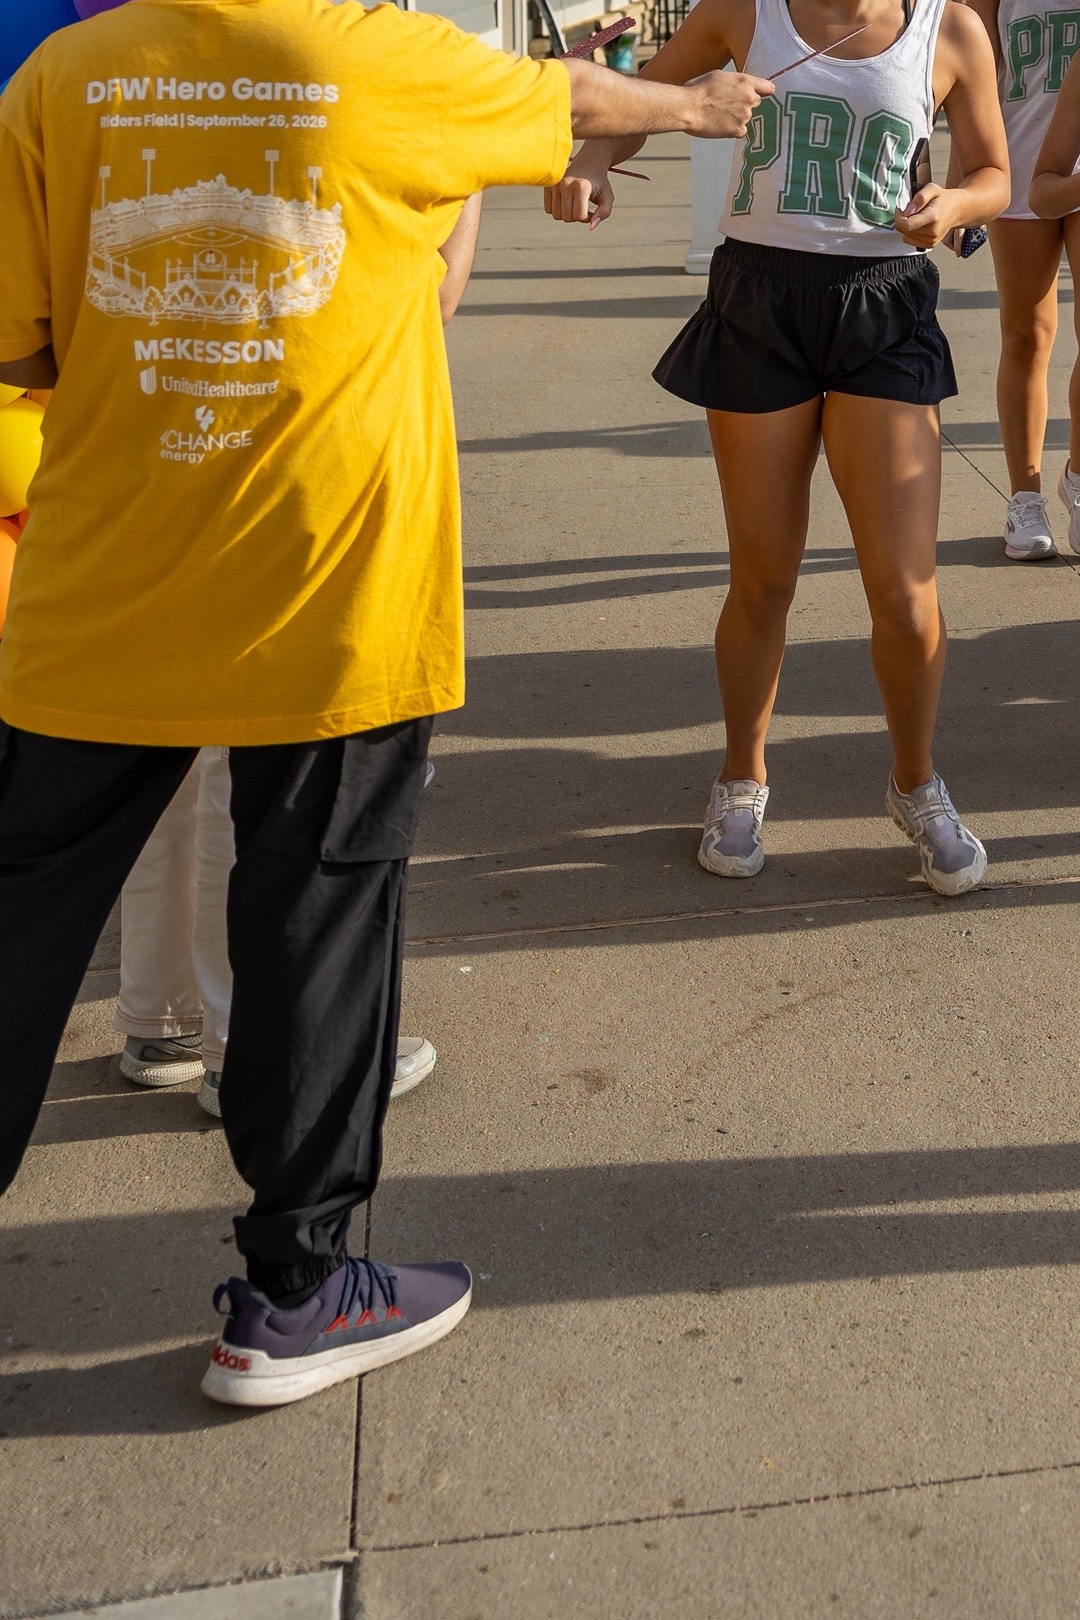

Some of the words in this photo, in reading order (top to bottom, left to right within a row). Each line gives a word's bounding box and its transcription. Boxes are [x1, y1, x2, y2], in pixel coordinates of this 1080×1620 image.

[86, 78, 150, 105] DFW
[156, 78, 226, 101] Hero
[232, 78, 339, 103] Games
[101, 114, 141, 129] Riders
[144, 113, 178, 128] Field
[186, 114, 266, 130] September
[268, 114, 289, 129] 26,
[292, 114, 328, 129] 2026
[731, 91, 915, 230] PRO
[161, 376, 279, 397] UnitedHealthcare
[160, 449, 206, 464] energy
